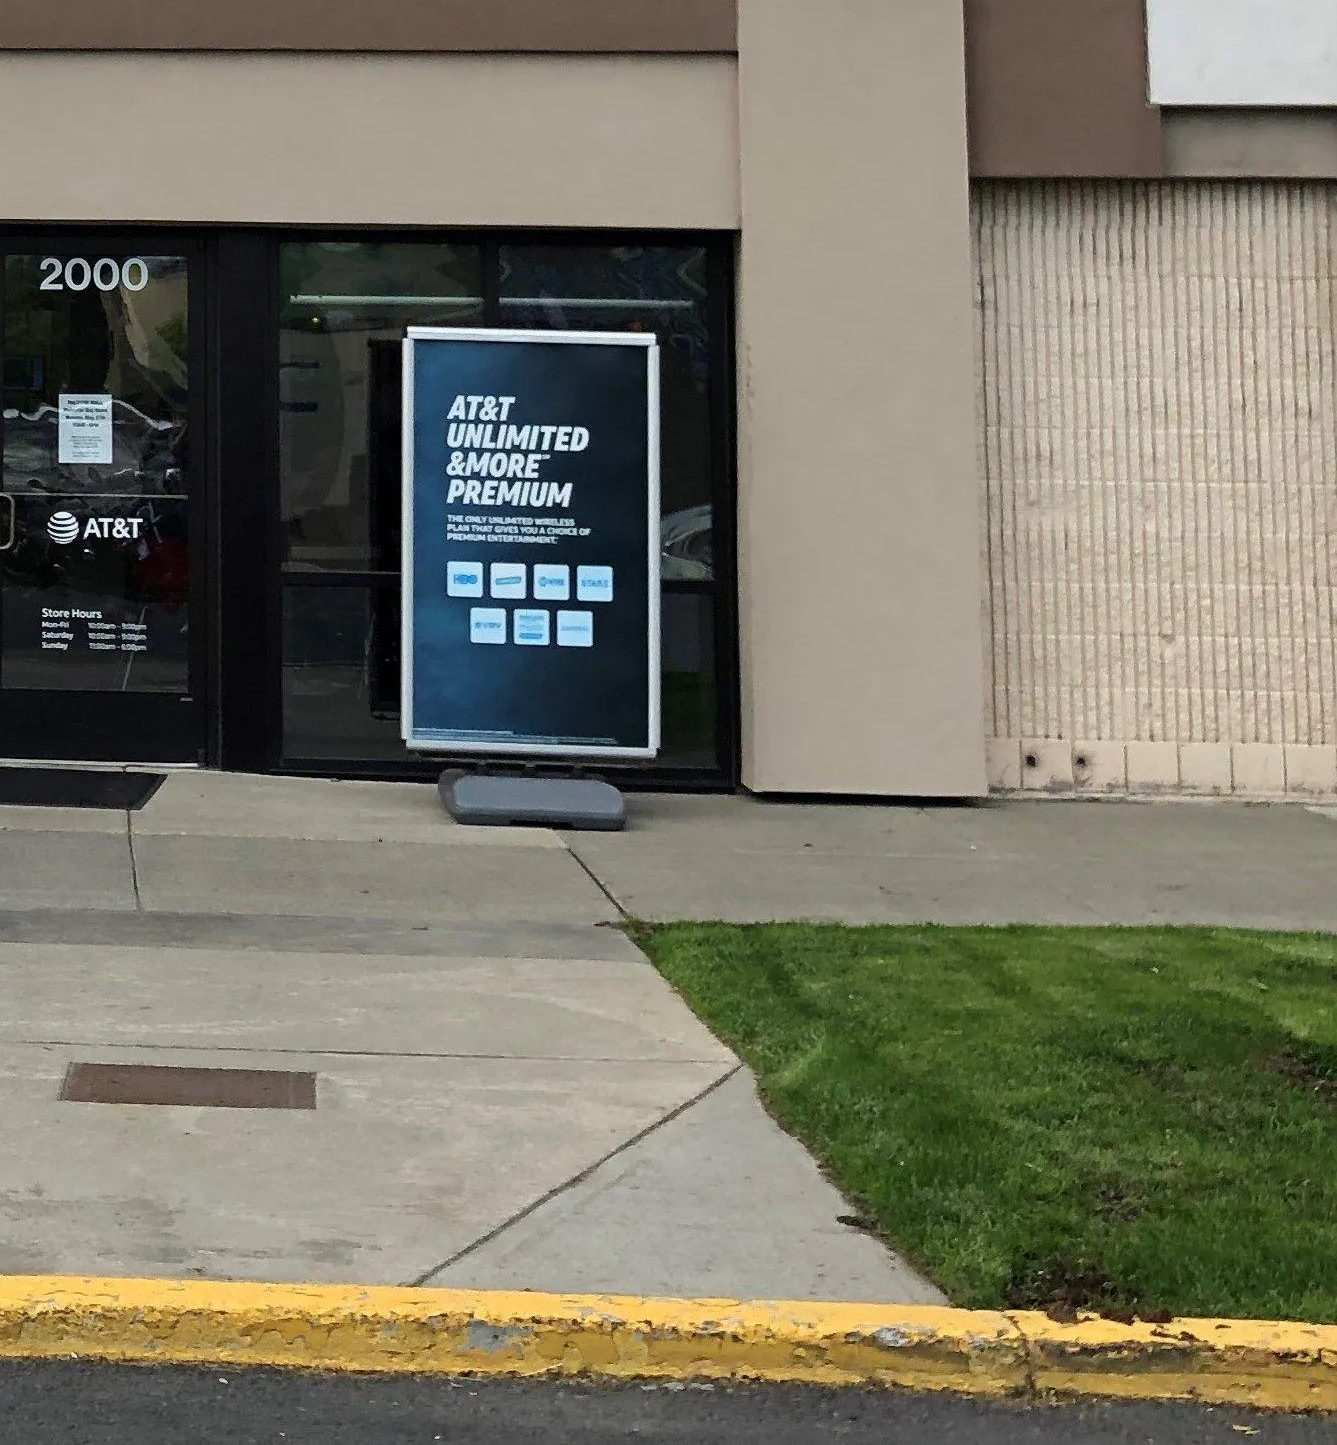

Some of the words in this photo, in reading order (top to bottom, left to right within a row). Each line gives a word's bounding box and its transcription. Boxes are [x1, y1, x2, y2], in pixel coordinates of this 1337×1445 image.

[40, 257, 149, 291] 2000
[447, 395, 516, 421] AT&T
[446, 423, 590, 452] UNLIMITED
[446, 479, 573, 508] PREMIUM
[448, 514, 463, 522] THE
[465, 515, 487, 523] ONLY
[488, 516, 533, 525] UNLIMITED
[83, 517, 143, 539] AT&T
[447, 524, 469, 532] PLAN
[471, 525, 493, 533] THAT
[494, 525, 518, 534] GIVES
[519, 526, 538, 534] YOU
[546, 527, 577, 535] CHOICE
[578, 528, 591, 536] OF
[447, 533, 486, 541] PREMIUM
[42, 607, 70, 618] Store
[71, 609, 102, 619] Hours
[42, 631, 74, 640] Saturday
[42, 642, 68, 650] Sunday
